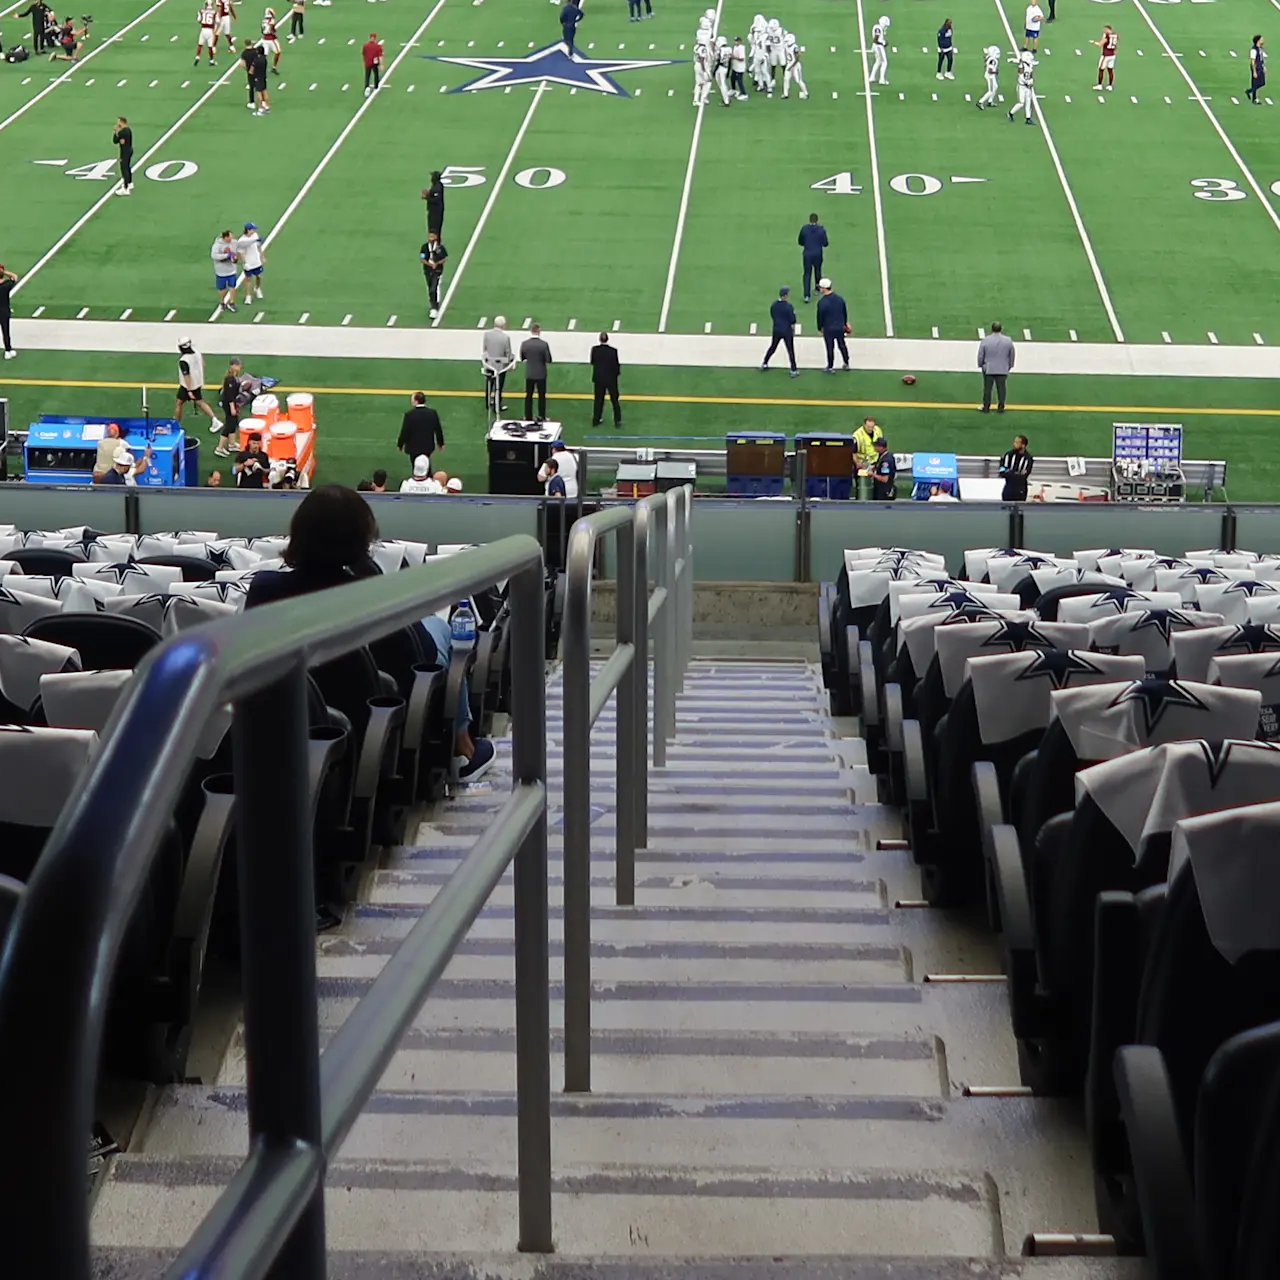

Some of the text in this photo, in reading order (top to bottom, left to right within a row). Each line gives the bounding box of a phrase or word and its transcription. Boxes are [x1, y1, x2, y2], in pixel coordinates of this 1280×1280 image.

[64, 159, 199, 182] 40
[439, 166, 566, 189] 50
[809, 172, 943, 196] 40
